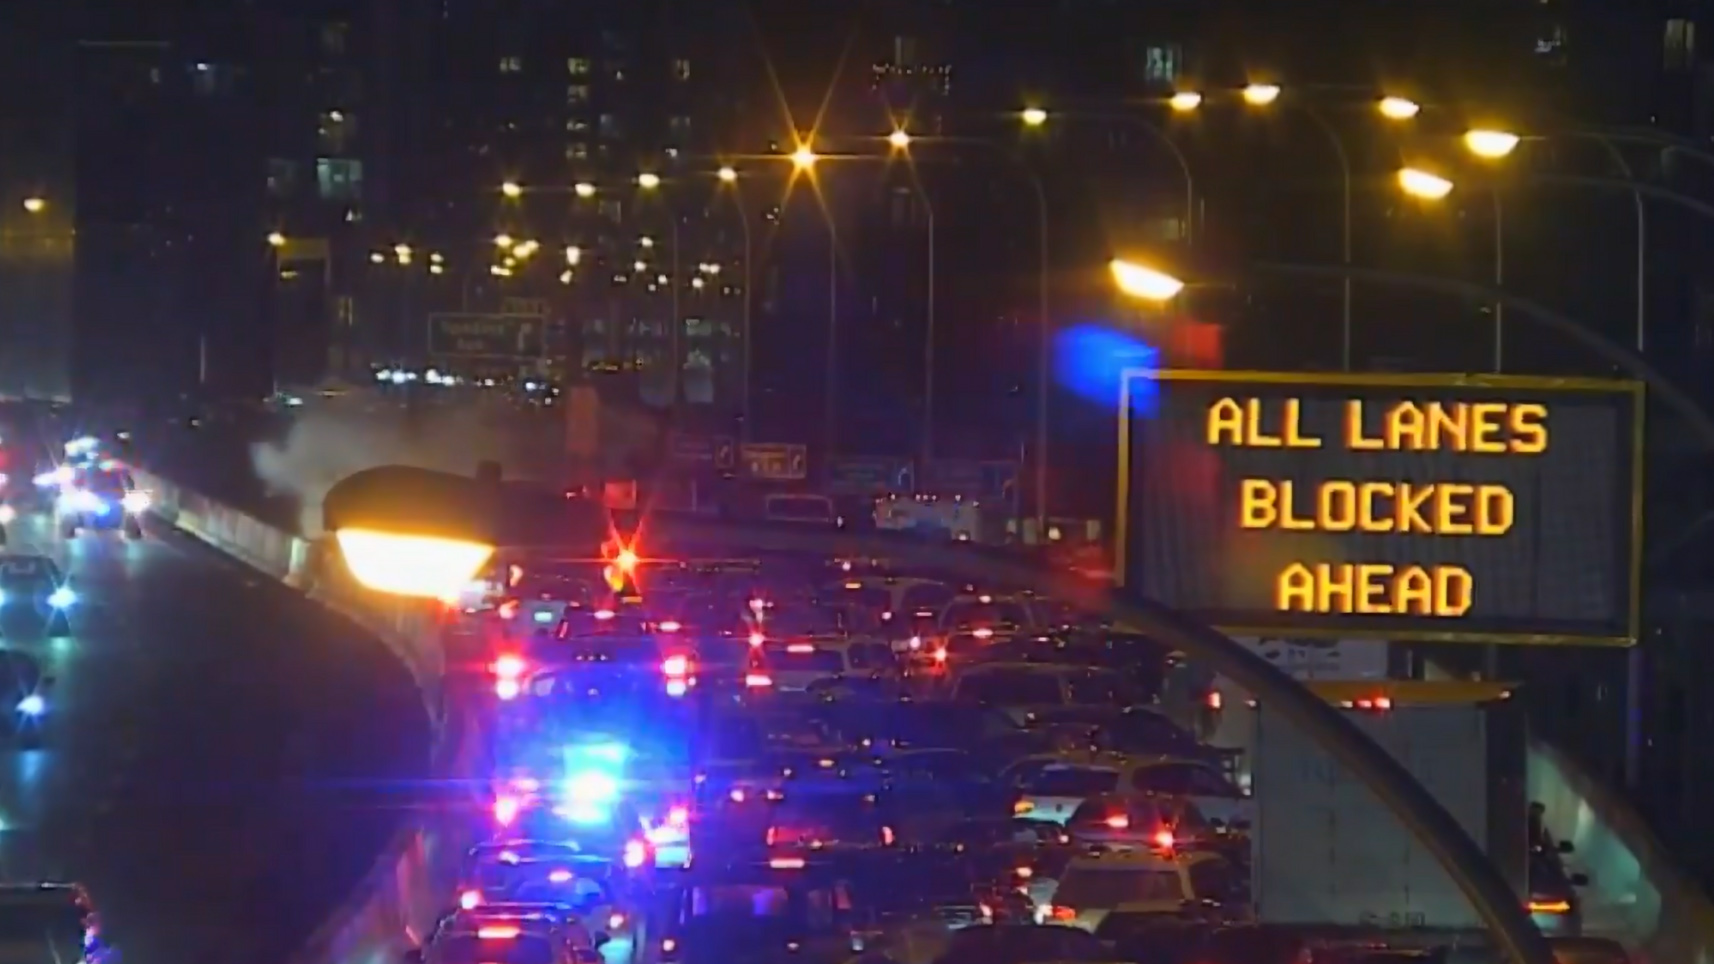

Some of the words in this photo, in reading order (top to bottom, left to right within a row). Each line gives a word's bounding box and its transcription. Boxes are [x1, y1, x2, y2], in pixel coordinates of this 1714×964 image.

[1206, 397, 1322, 447] ALL
[1347, 400, 1549, 454] LANES
[1240, 479, 1514, 537] BLOCKED
[1277, 562, 1474, 617] AHEAD
